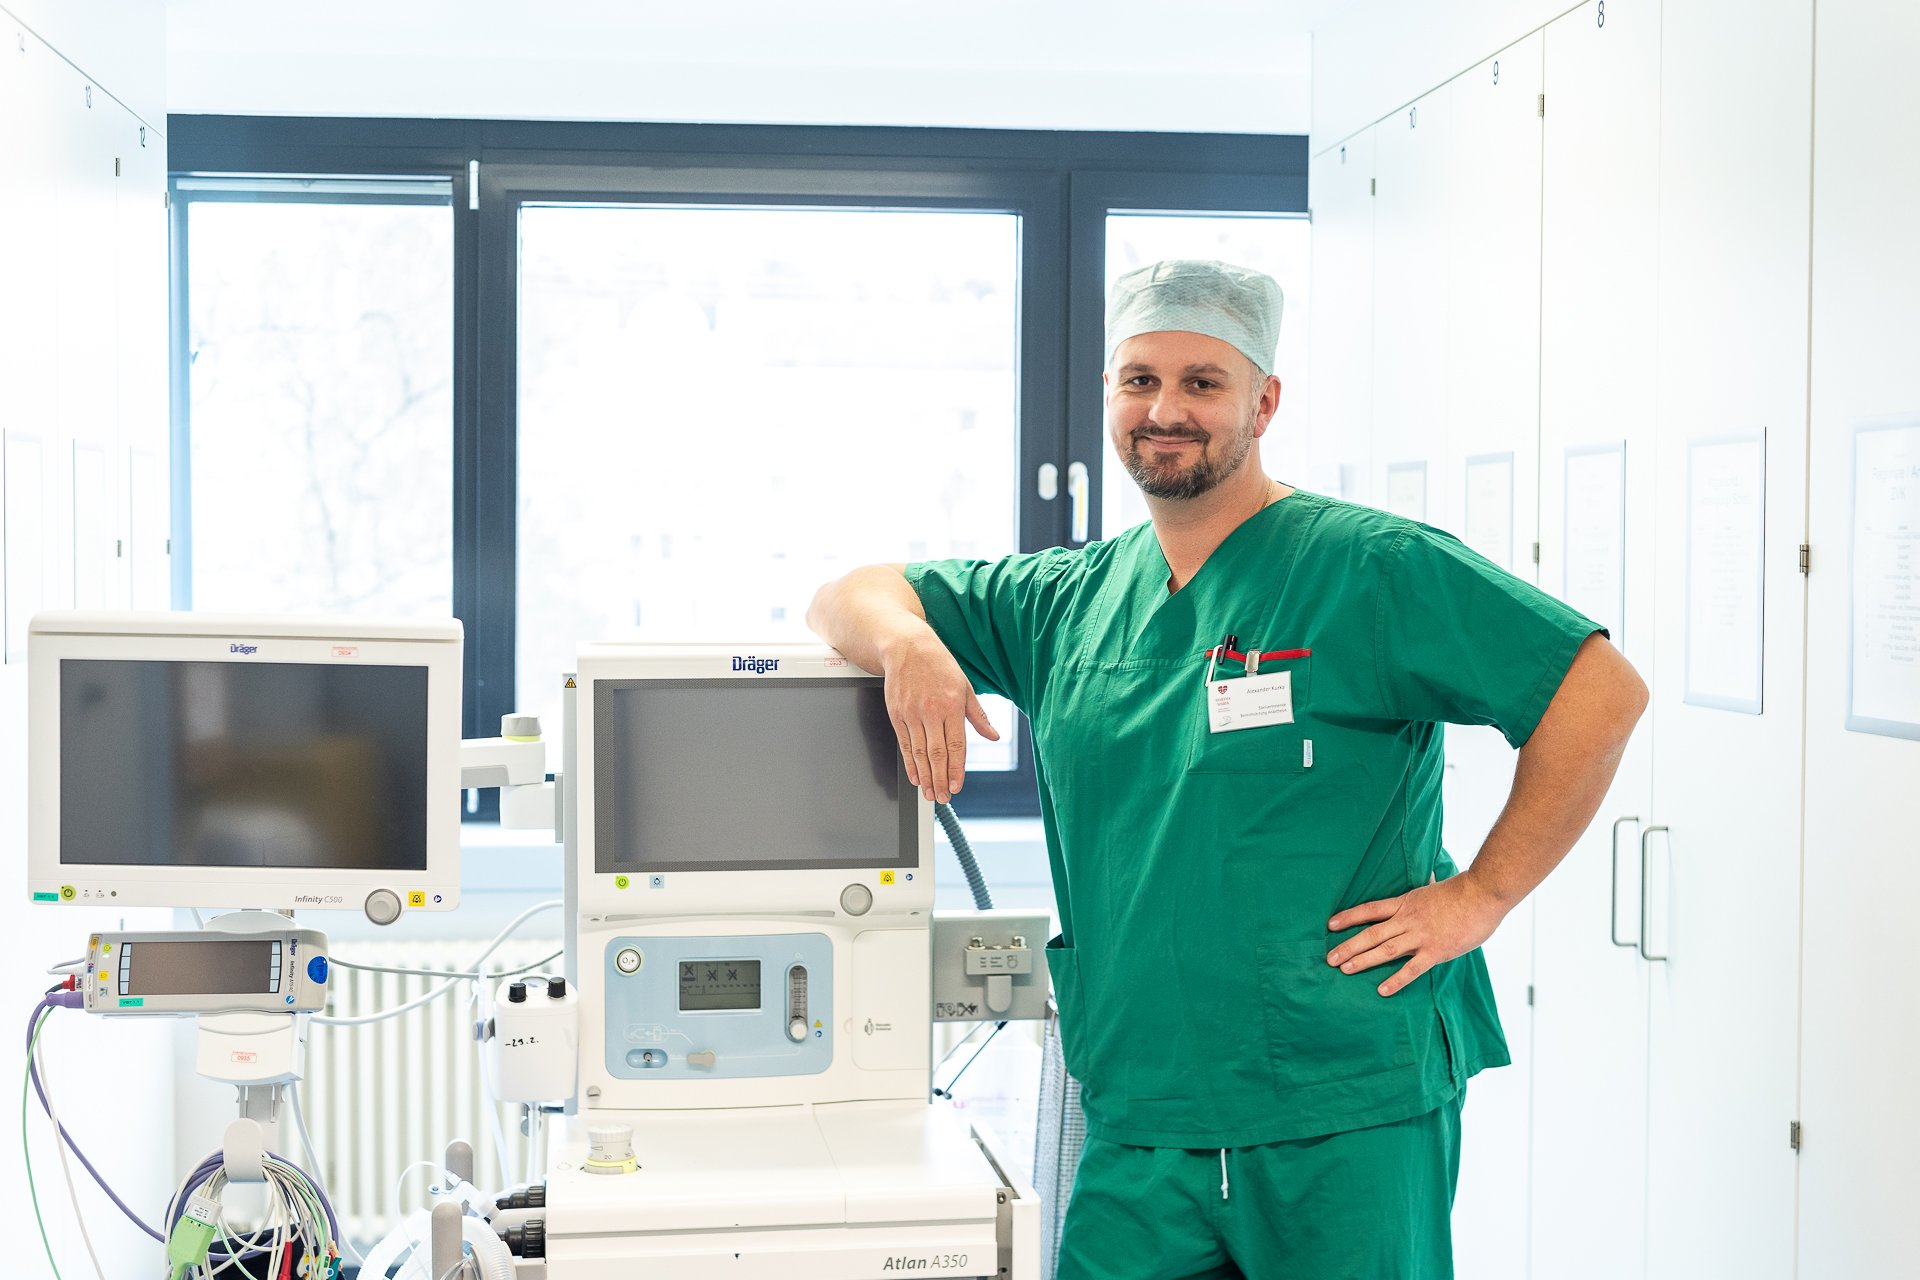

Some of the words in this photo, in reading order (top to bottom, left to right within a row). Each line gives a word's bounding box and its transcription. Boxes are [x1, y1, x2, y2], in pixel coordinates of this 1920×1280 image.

[1598, 0, 1605, 28] 8
[1493, 60, 1499, 86] 9
[732, 655, 780, 675] Dräger
[294, 895, 323, 905] Infinity
[324, 895, 344, 904] C500
[883, 1256, 927, 1271] Atlan
[930, 1254, 968, 1269] A350
